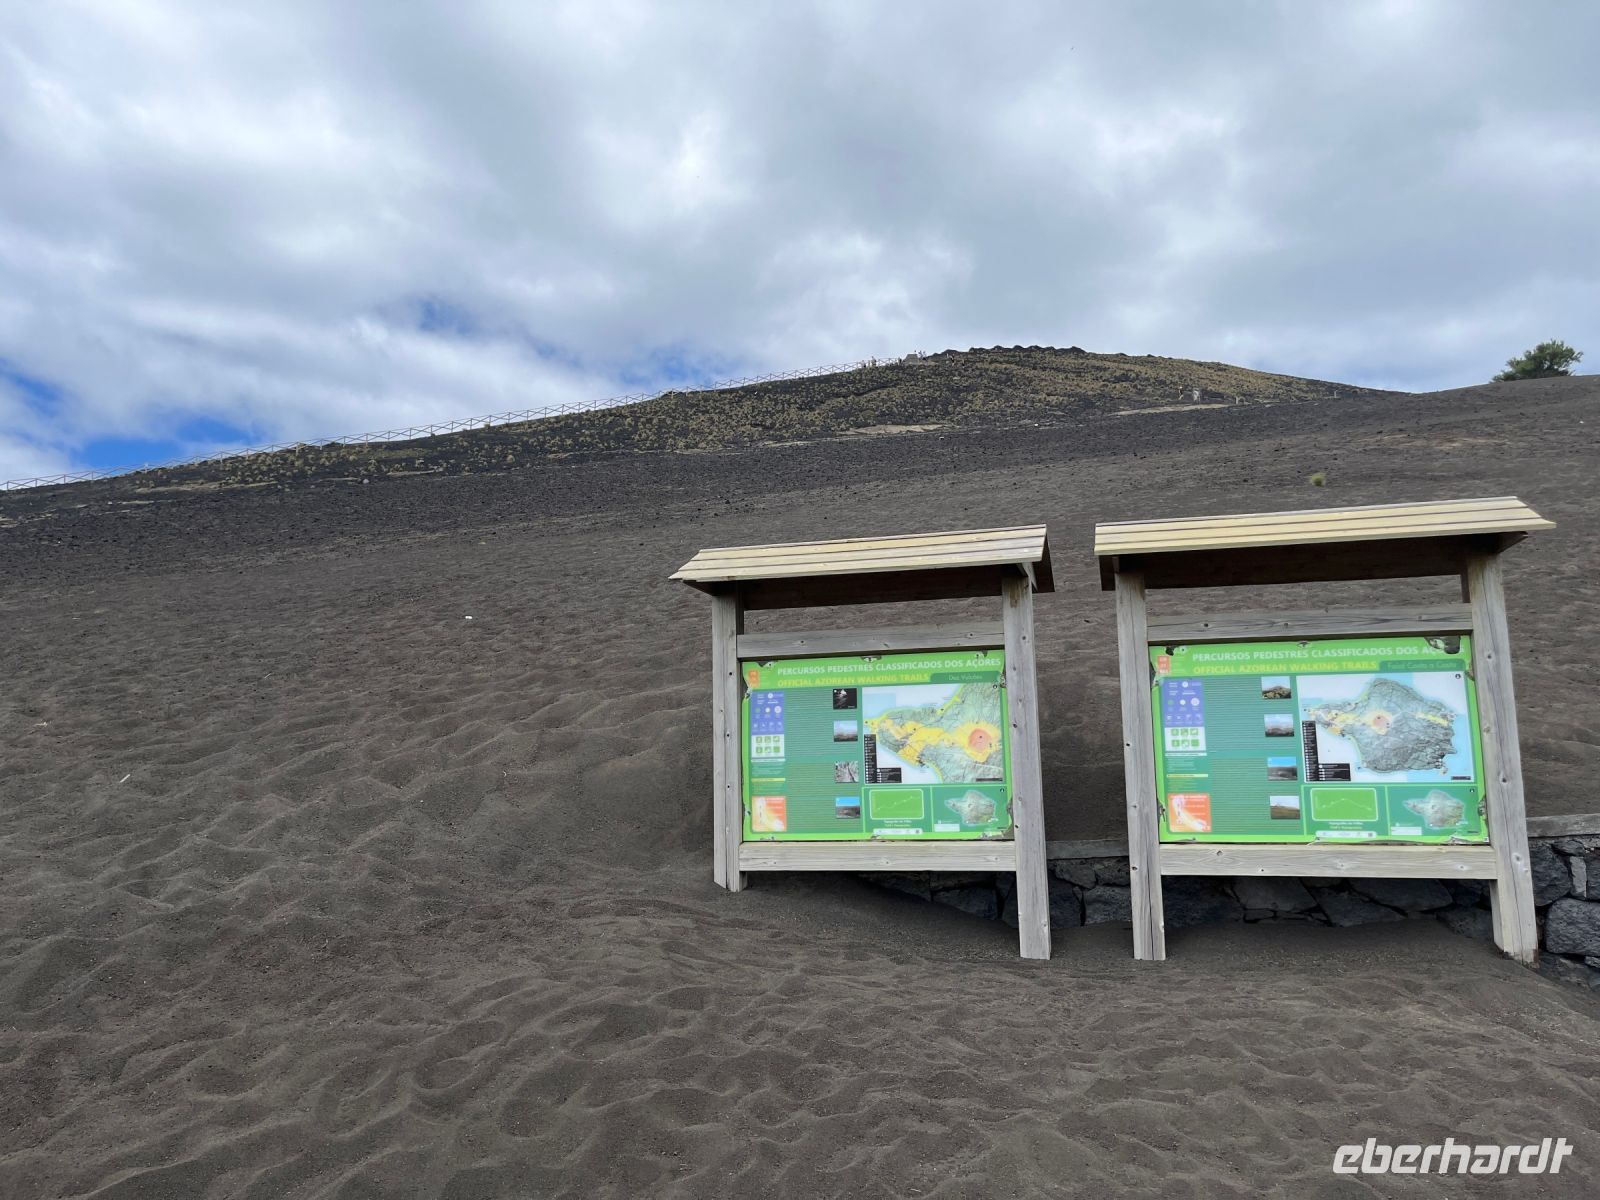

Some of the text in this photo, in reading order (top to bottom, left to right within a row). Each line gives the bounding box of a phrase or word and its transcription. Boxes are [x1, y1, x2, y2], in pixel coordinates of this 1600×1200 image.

[1192, 652, 1250, 662] PERCURSOS
[1253, 650, 1309, 660] PEDESTRES
[1311, 647, 1393, 658] CLASSIFICADOS
[1395, 646, 1418, 656] DOS
[777, 657, 1001, 676] PERCURSOS PEDESTRES CLASSIFICADOS DOS AÇORES
[1193, 665, 1235, 675] OFFICIAL
[1238, 663, 1285, 674] AZOREAN
[1289, 661, 1339, 672] WALKING
[1343, 660, 1377, 670] TRAILS
[777, 678, 815, 688] OFFICIAL
[816, 677, 855, 687] AZOREAN
[857, 674, 897, 685] WALKING
[899, 673, 929, 683] TRAILS
